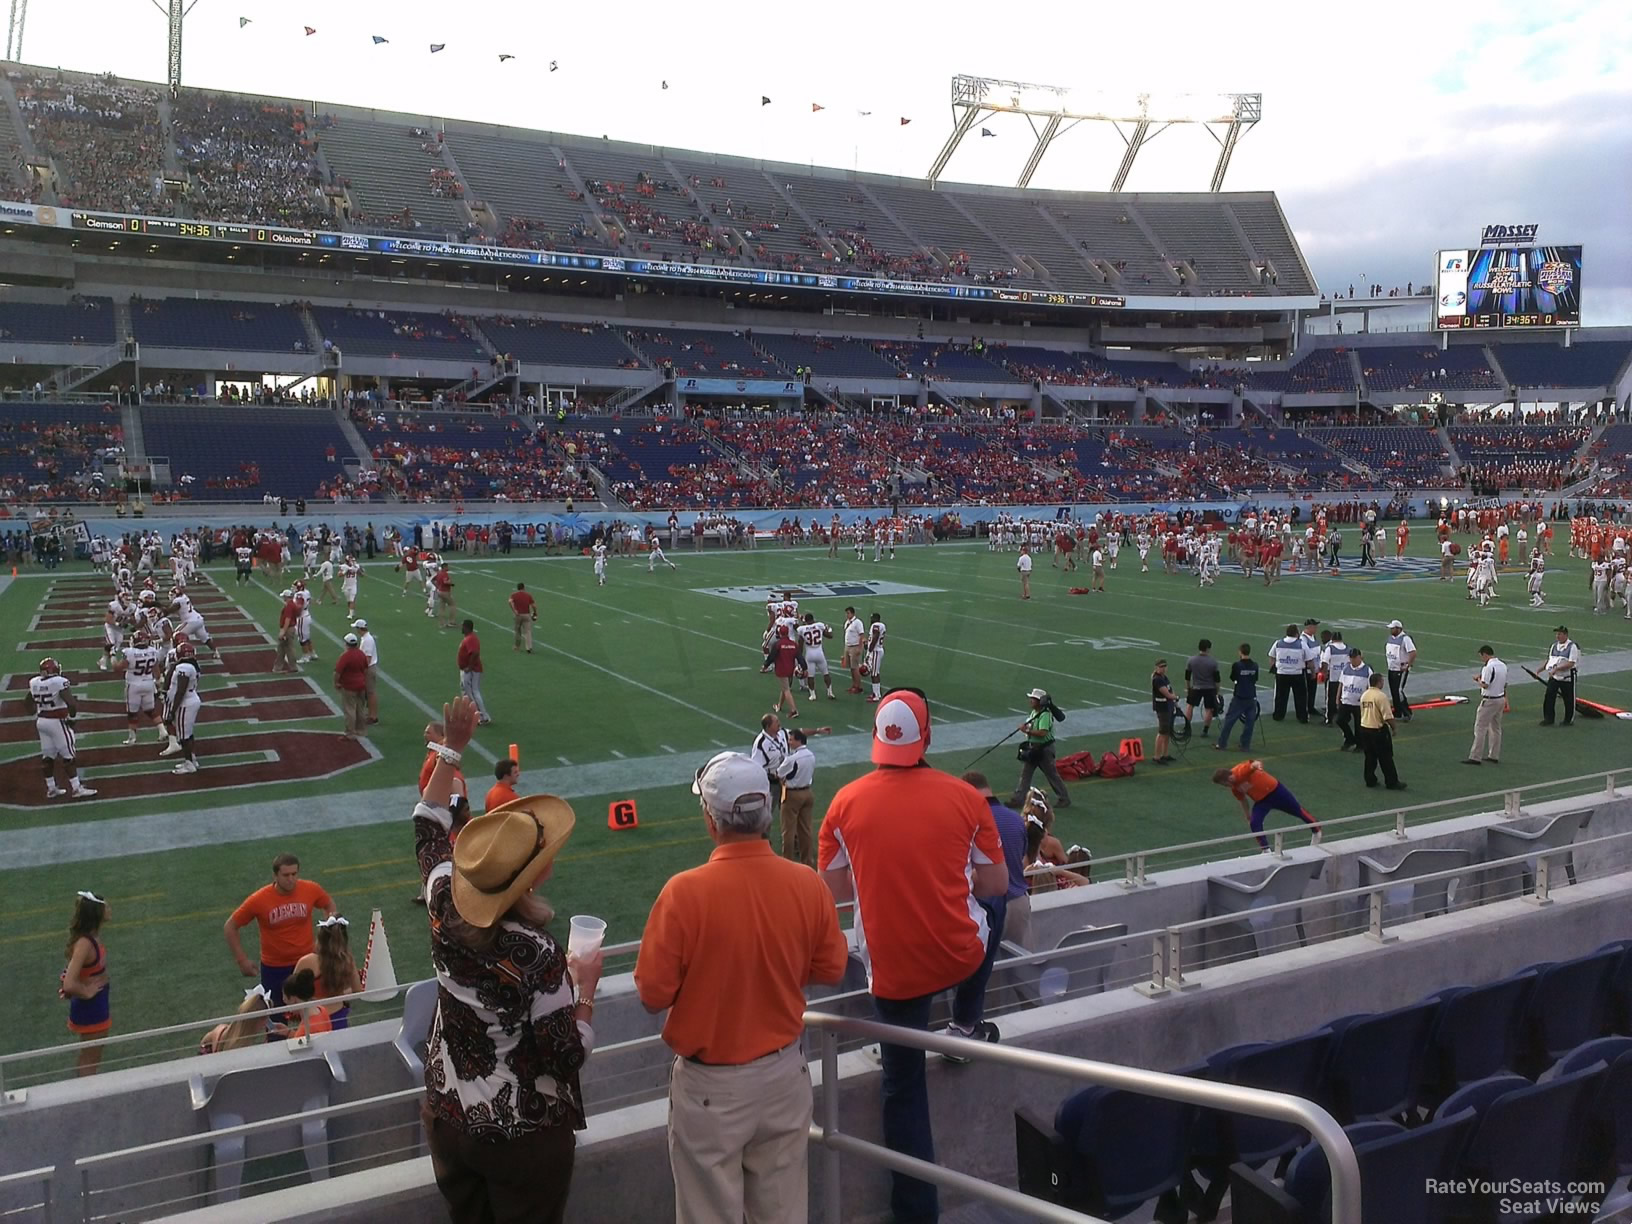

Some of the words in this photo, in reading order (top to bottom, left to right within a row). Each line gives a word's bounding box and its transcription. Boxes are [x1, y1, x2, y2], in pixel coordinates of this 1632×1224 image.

[86, 219, 124, 230] Clemson
[180, 223, 210, 237] 34:36
[1484, 224, 1539, 238] MASSEY
[272, 233, 312, 245] Oklahoma
[1506, 315, 1530, 325] 34:36
[803, 629, 822, 646] 32
[134, 658, 156, 676] 56
[1125, 741, 1142, 757] 10
[614, 803, 635, 826] G
[269, 902, 308, 924] CLEMSON
[1051, 1172, 1058, 1186] D
